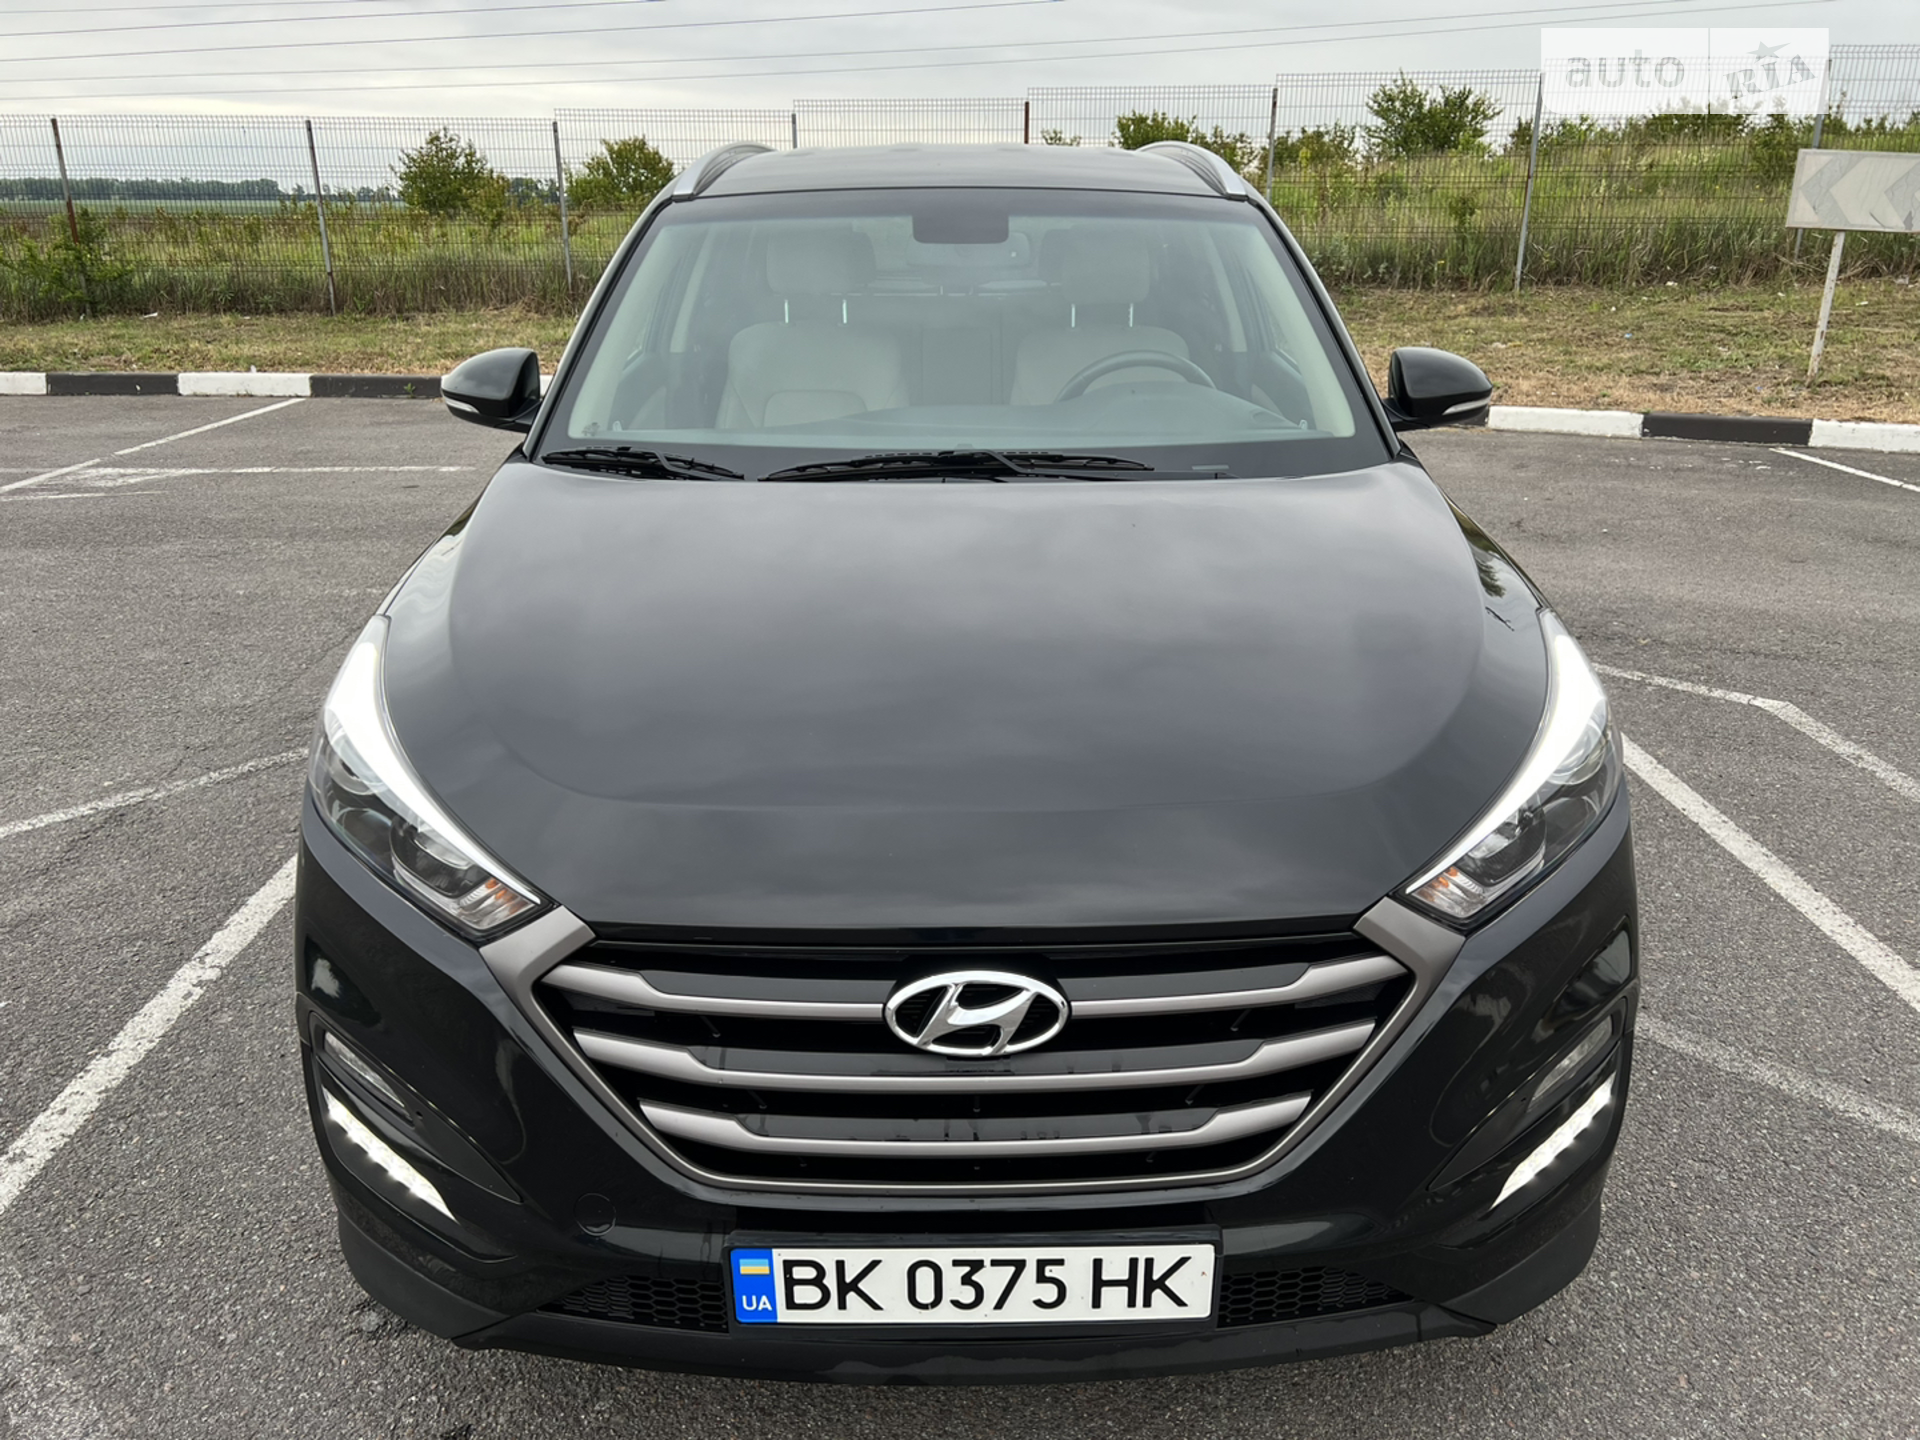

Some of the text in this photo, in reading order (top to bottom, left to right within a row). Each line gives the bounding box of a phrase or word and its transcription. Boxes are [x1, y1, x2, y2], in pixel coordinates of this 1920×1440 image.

[781, 1256, 1193, 1311] BK 0375 HK
[742, 1295, 773, 1312] UA
